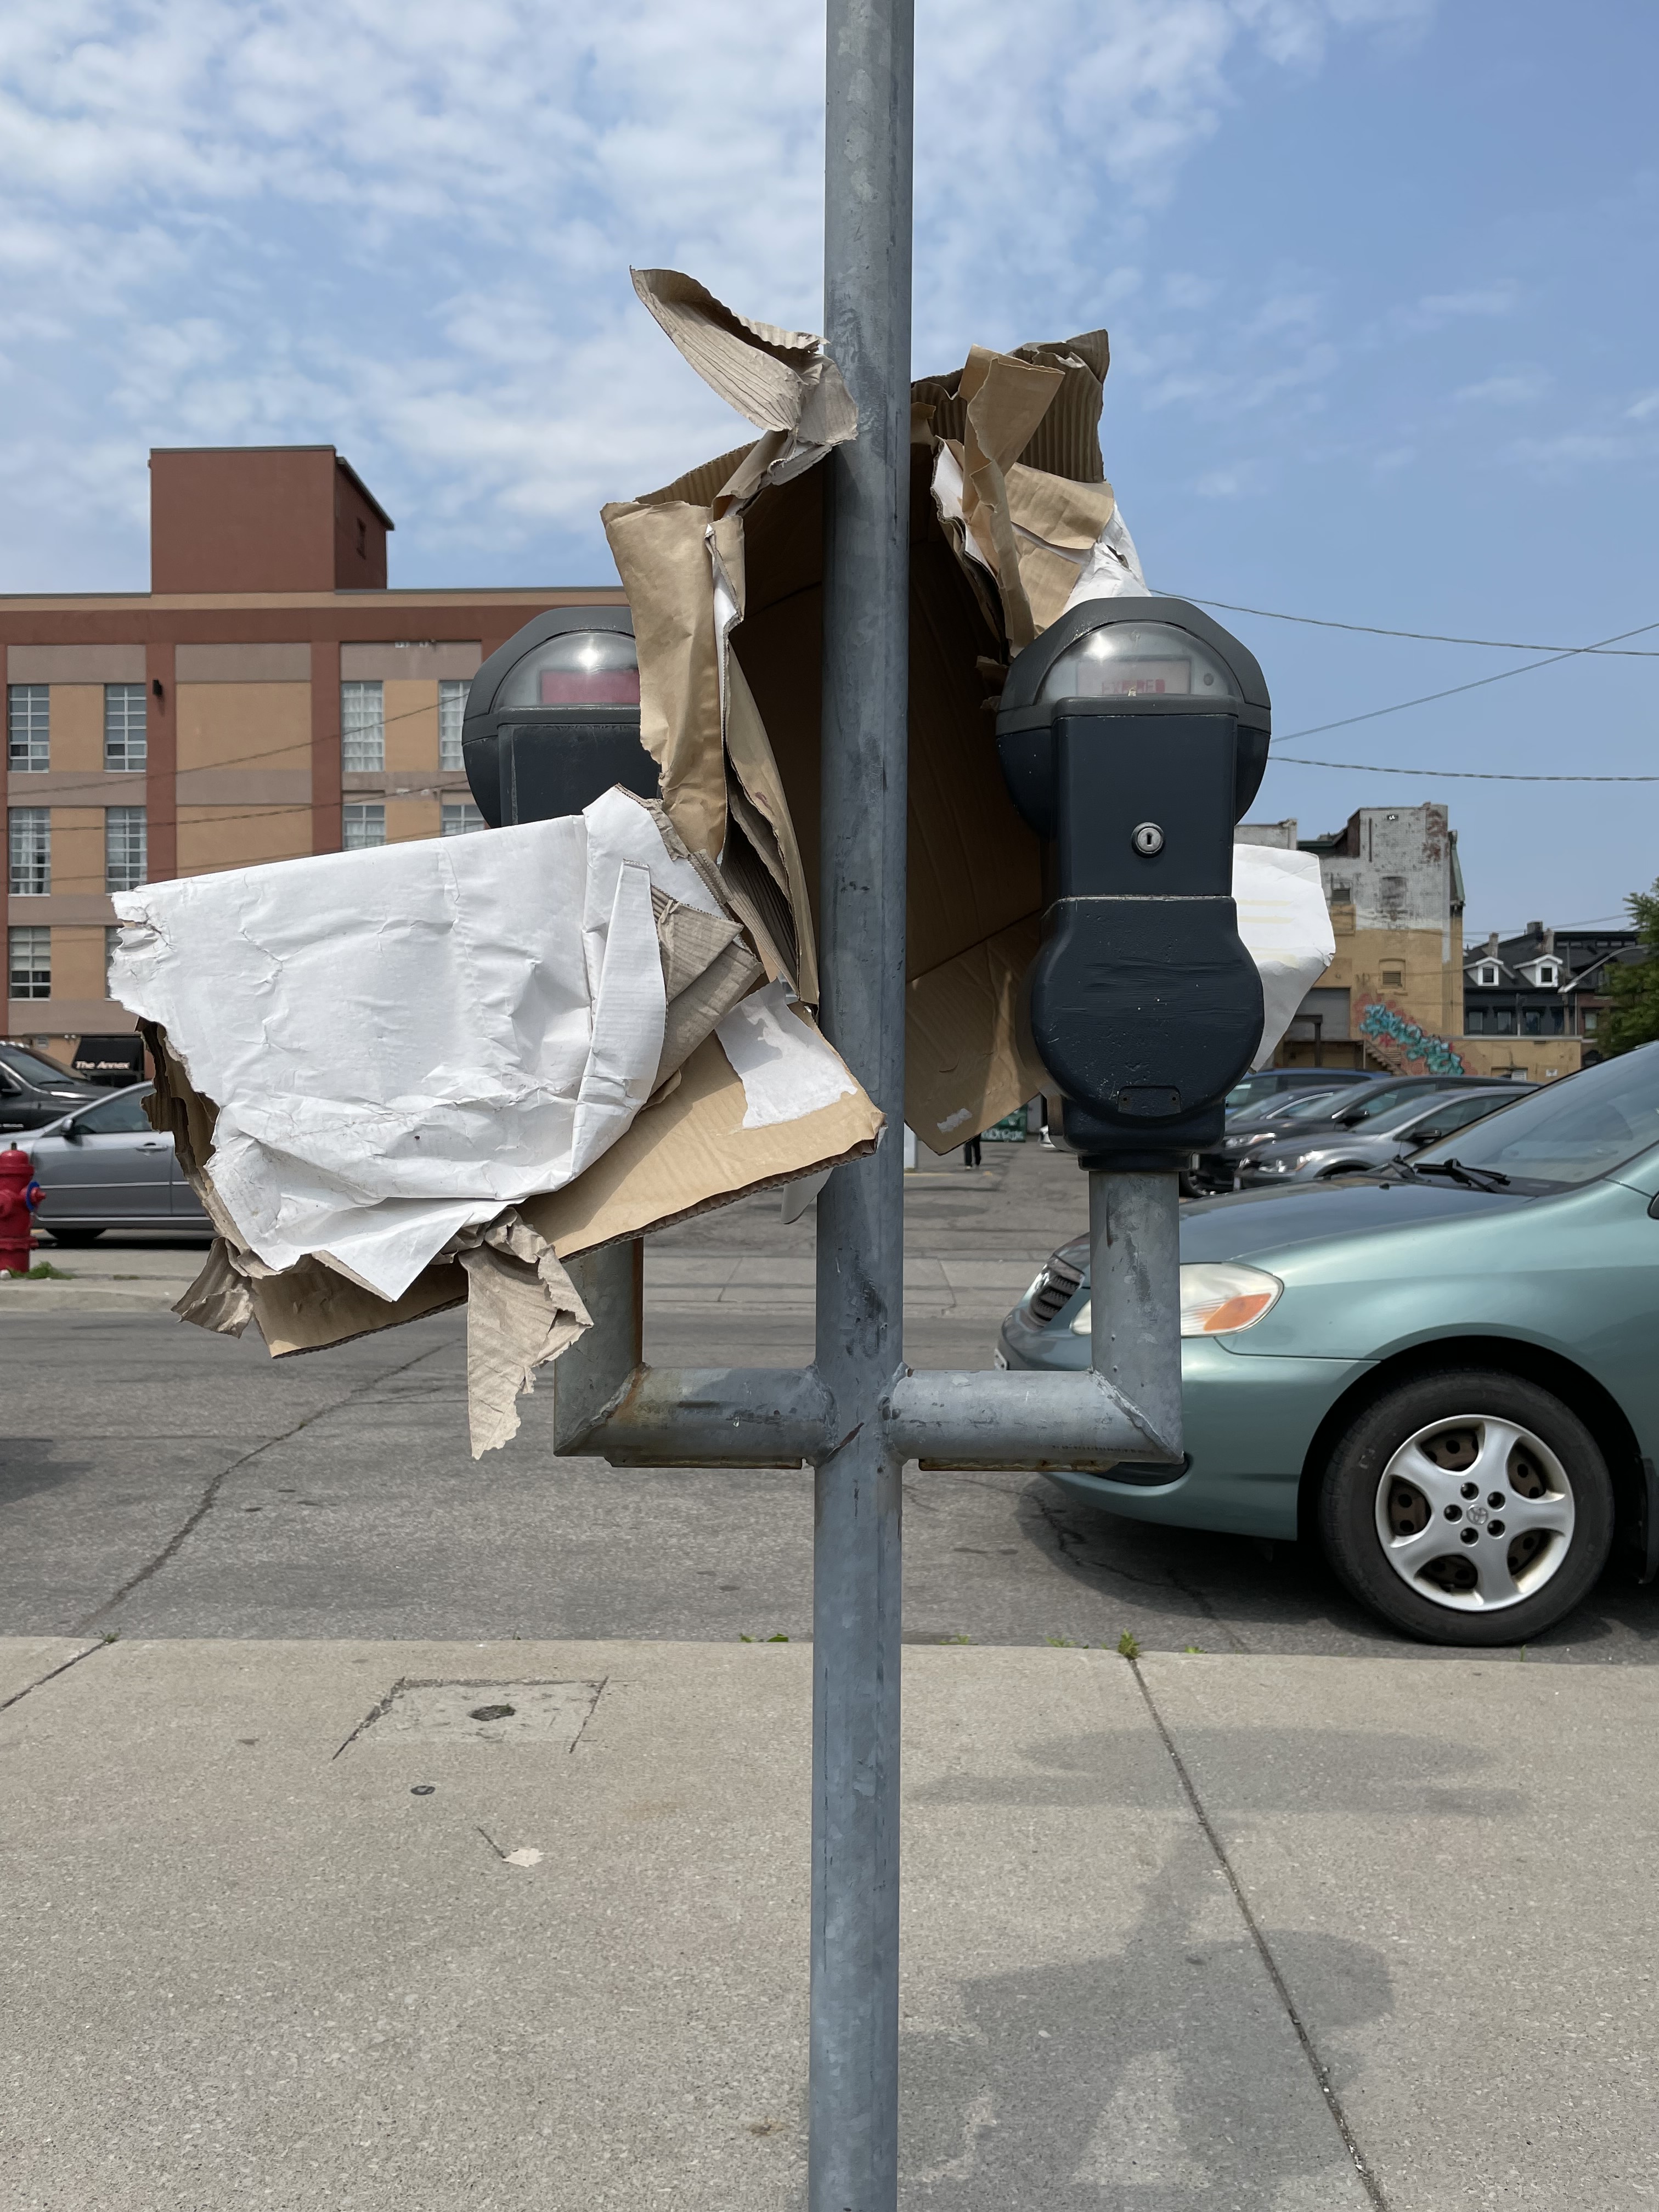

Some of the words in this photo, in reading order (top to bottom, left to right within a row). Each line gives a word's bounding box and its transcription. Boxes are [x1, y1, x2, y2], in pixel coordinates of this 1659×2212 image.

[1102, 679, 1165, 695] EXPRED
[75, 1060, 95, 1069] The
[97, 1060, 130, 1069] Annex
